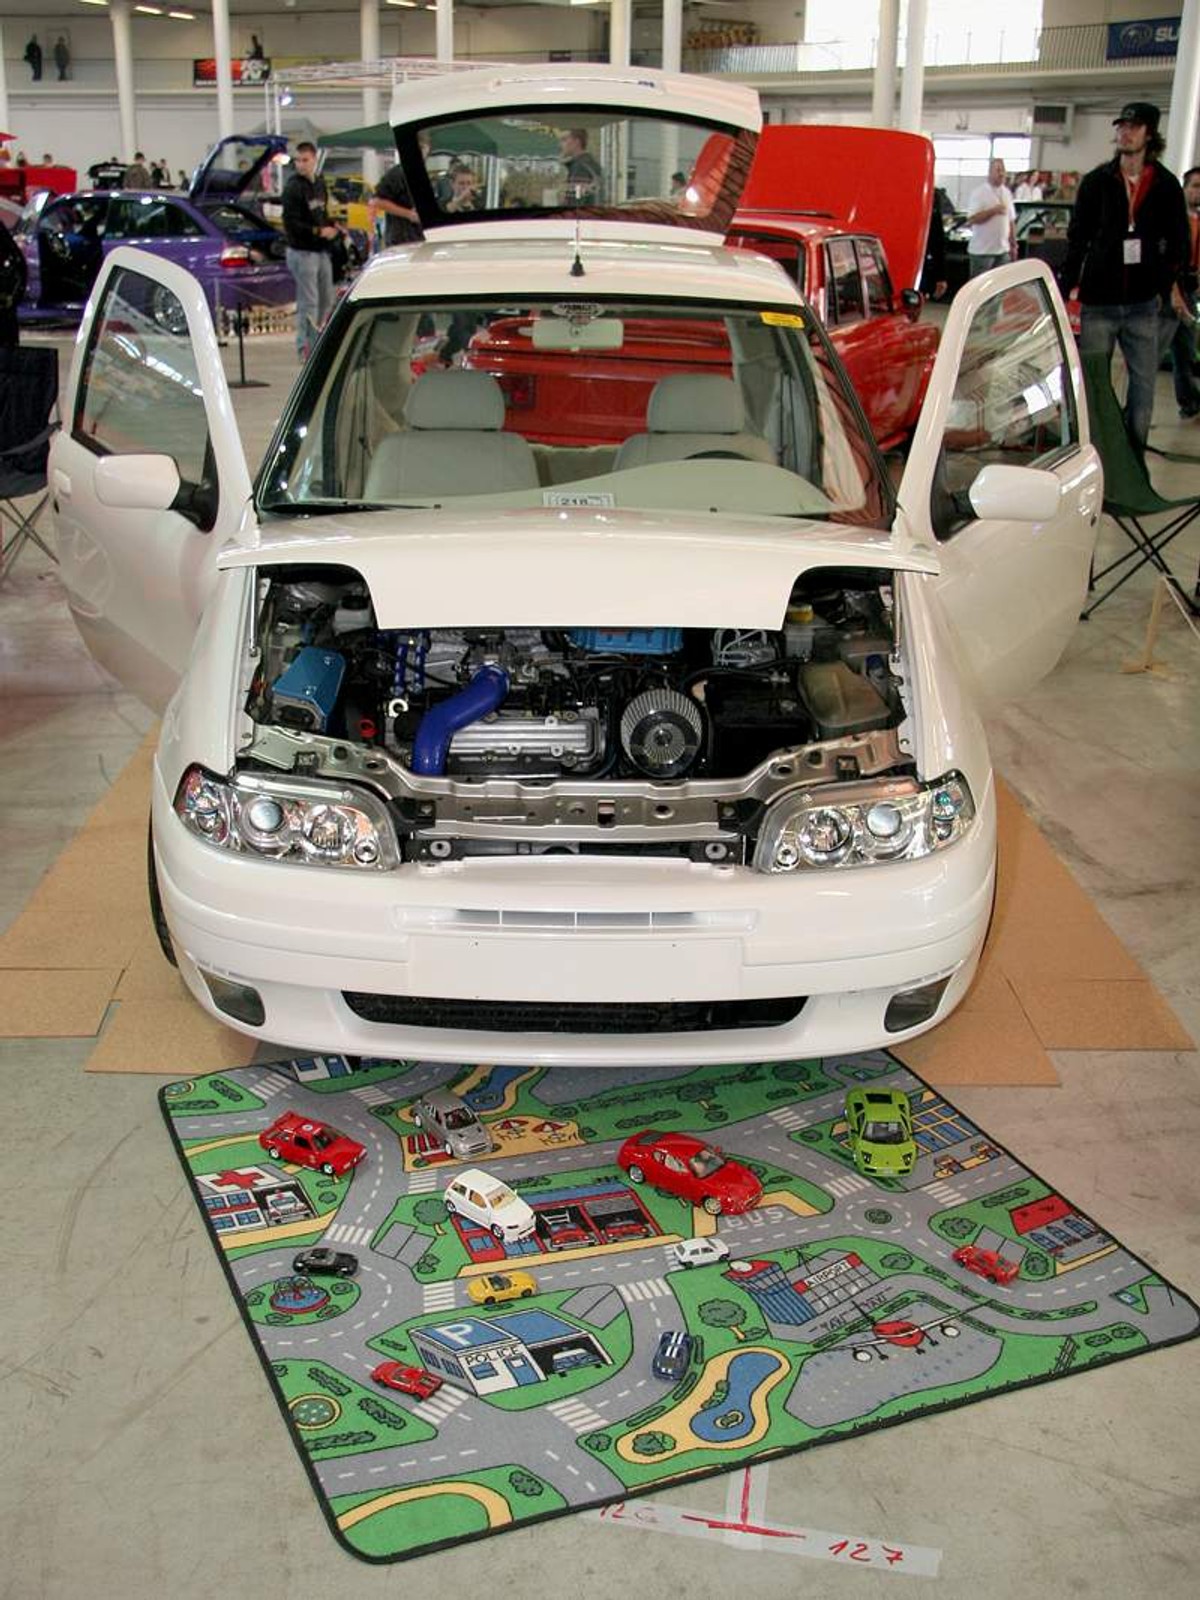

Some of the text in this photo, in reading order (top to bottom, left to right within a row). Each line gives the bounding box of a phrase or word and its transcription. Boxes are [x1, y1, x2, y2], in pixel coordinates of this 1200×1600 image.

[724, 1206, 784, 1229] BUS
[805, 1259, 852, 1288] AIRPORT
[433, 1323, 473, 1347] P
[465, 1344, 520, 1366] POLICE
[828, 1540, 904, 1566] 127
